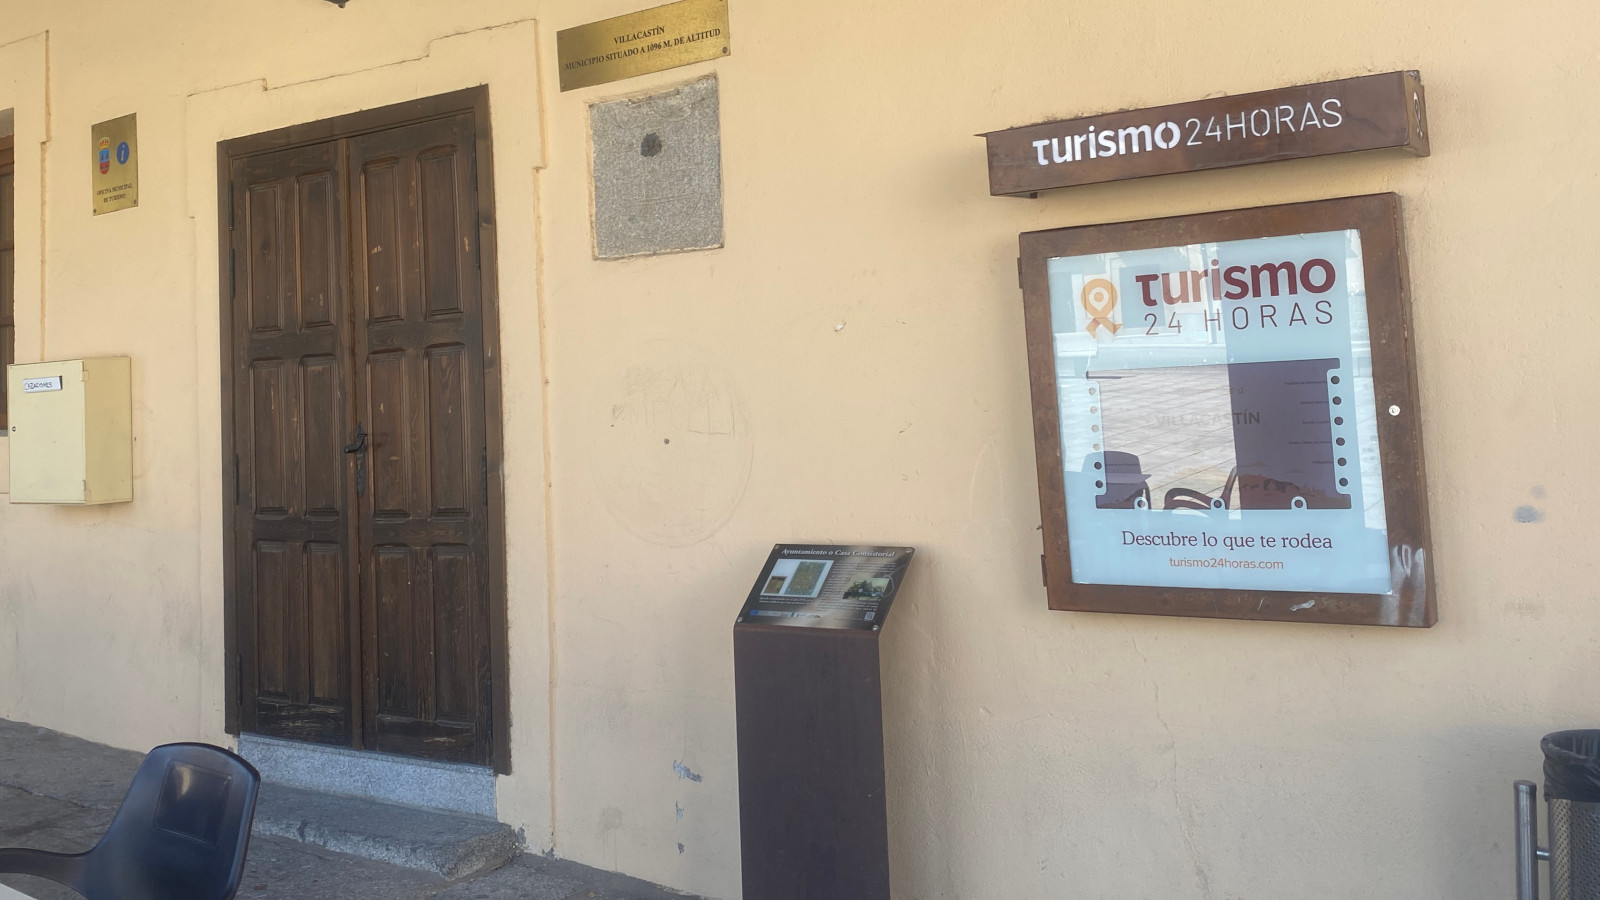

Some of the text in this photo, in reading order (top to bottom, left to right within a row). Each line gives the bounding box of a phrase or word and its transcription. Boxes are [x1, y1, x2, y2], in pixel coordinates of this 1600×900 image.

[613, 25, 666, 45] VILLACASTÍN
[565, 28, 721, 71] MUNICIPIO SITUADO A 1096 M. DE ALTITUD
[1032, 121, 1181, 166] turismo
[1135, 258, 1336, 307] turismo
[1144, 300, 1334, 336] 24 HORAS
[1155, 409, 1261, 428] VILLACASTÍN
[1121, 530, 1333, 550] Descubre lo que te rodea
[781, 548, 828, 556] Ayuntamiento
[852, 550, 896, 558] Consistorial
[1169, 557, 1284, 570] turismo24horas.com
